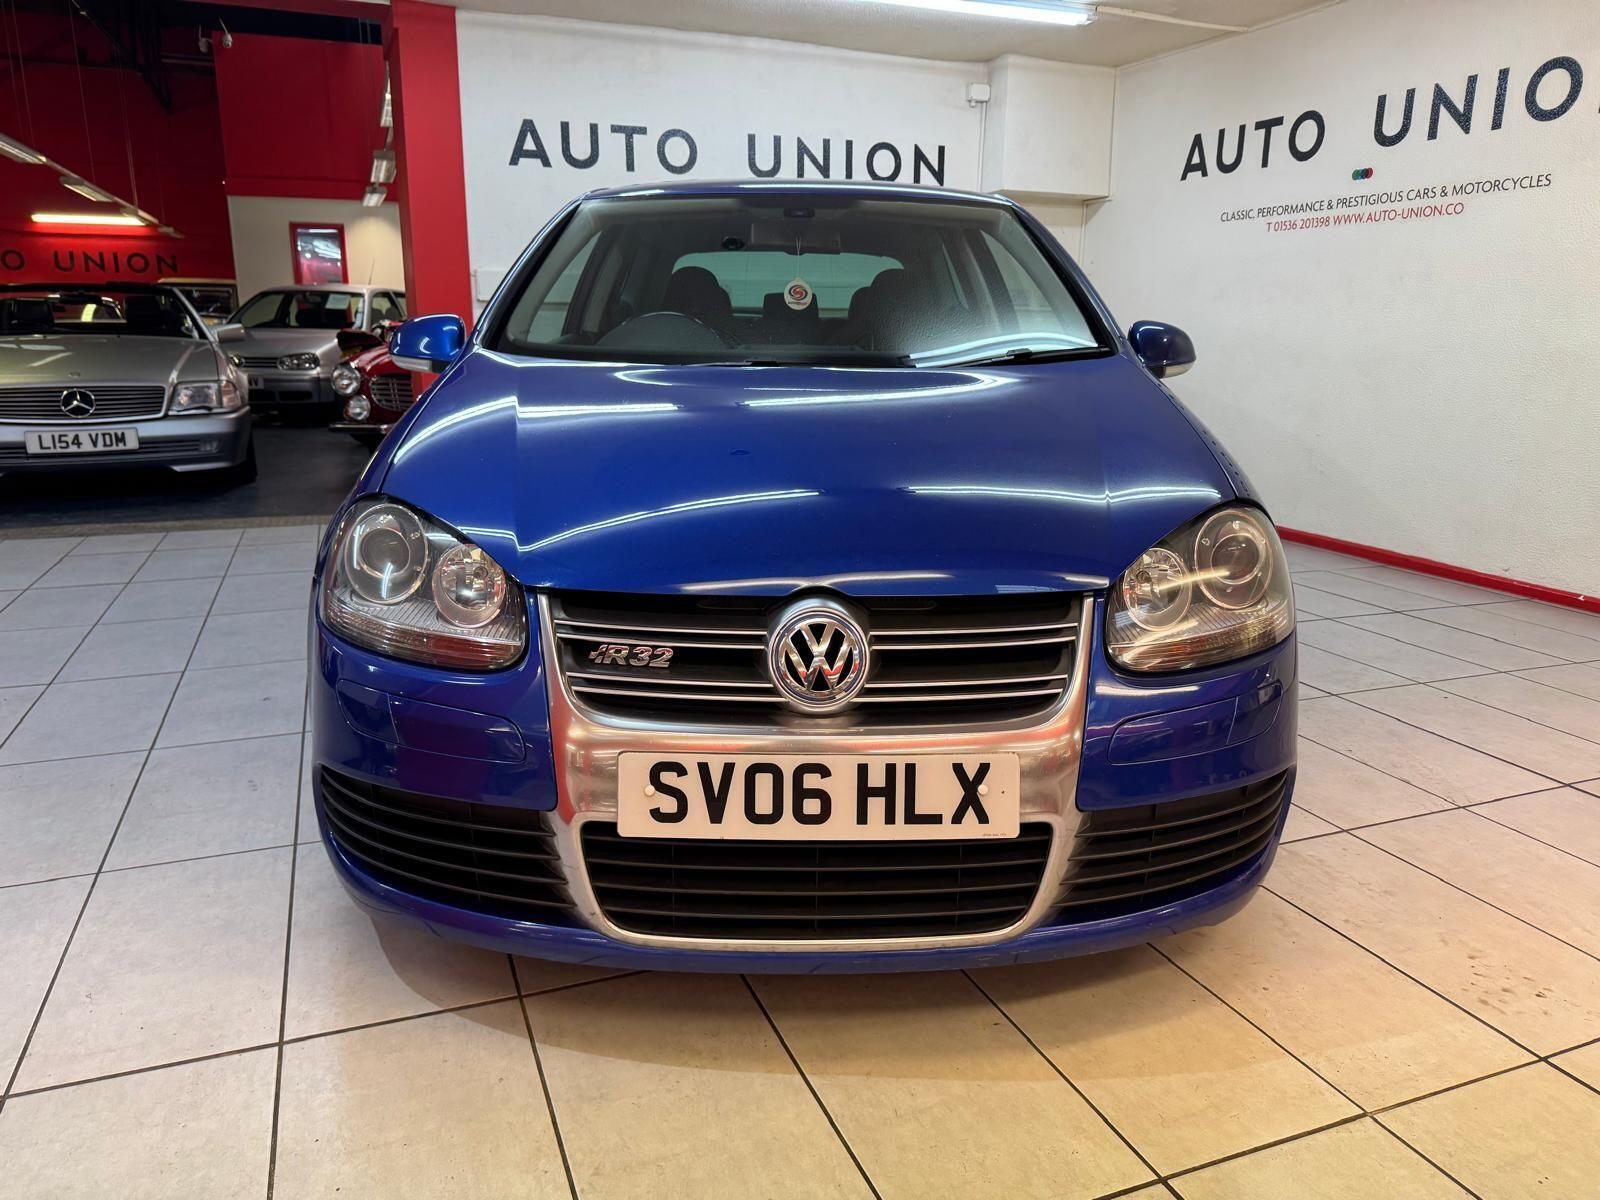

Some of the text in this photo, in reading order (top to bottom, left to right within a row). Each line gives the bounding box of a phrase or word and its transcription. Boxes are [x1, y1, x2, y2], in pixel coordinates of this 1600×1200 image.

[1179, 55, 1600, 181] AUTO UNIO
[508, 118, 945, 186] AUTO UNION
[1220, 173, 1552, 223] CLASSIC, PERFORMANCE & PRESTIGIOUS CARS & MOTORCYCLES
[1266, 202, 1465, 232] T 01536 201398 WWW.AUTO-UNION.CO
[53, 250, 179, 274] UNION
[38, 431, 127, 451] L154 VDM
[649, 761, 991, 825] SV06 HLX
